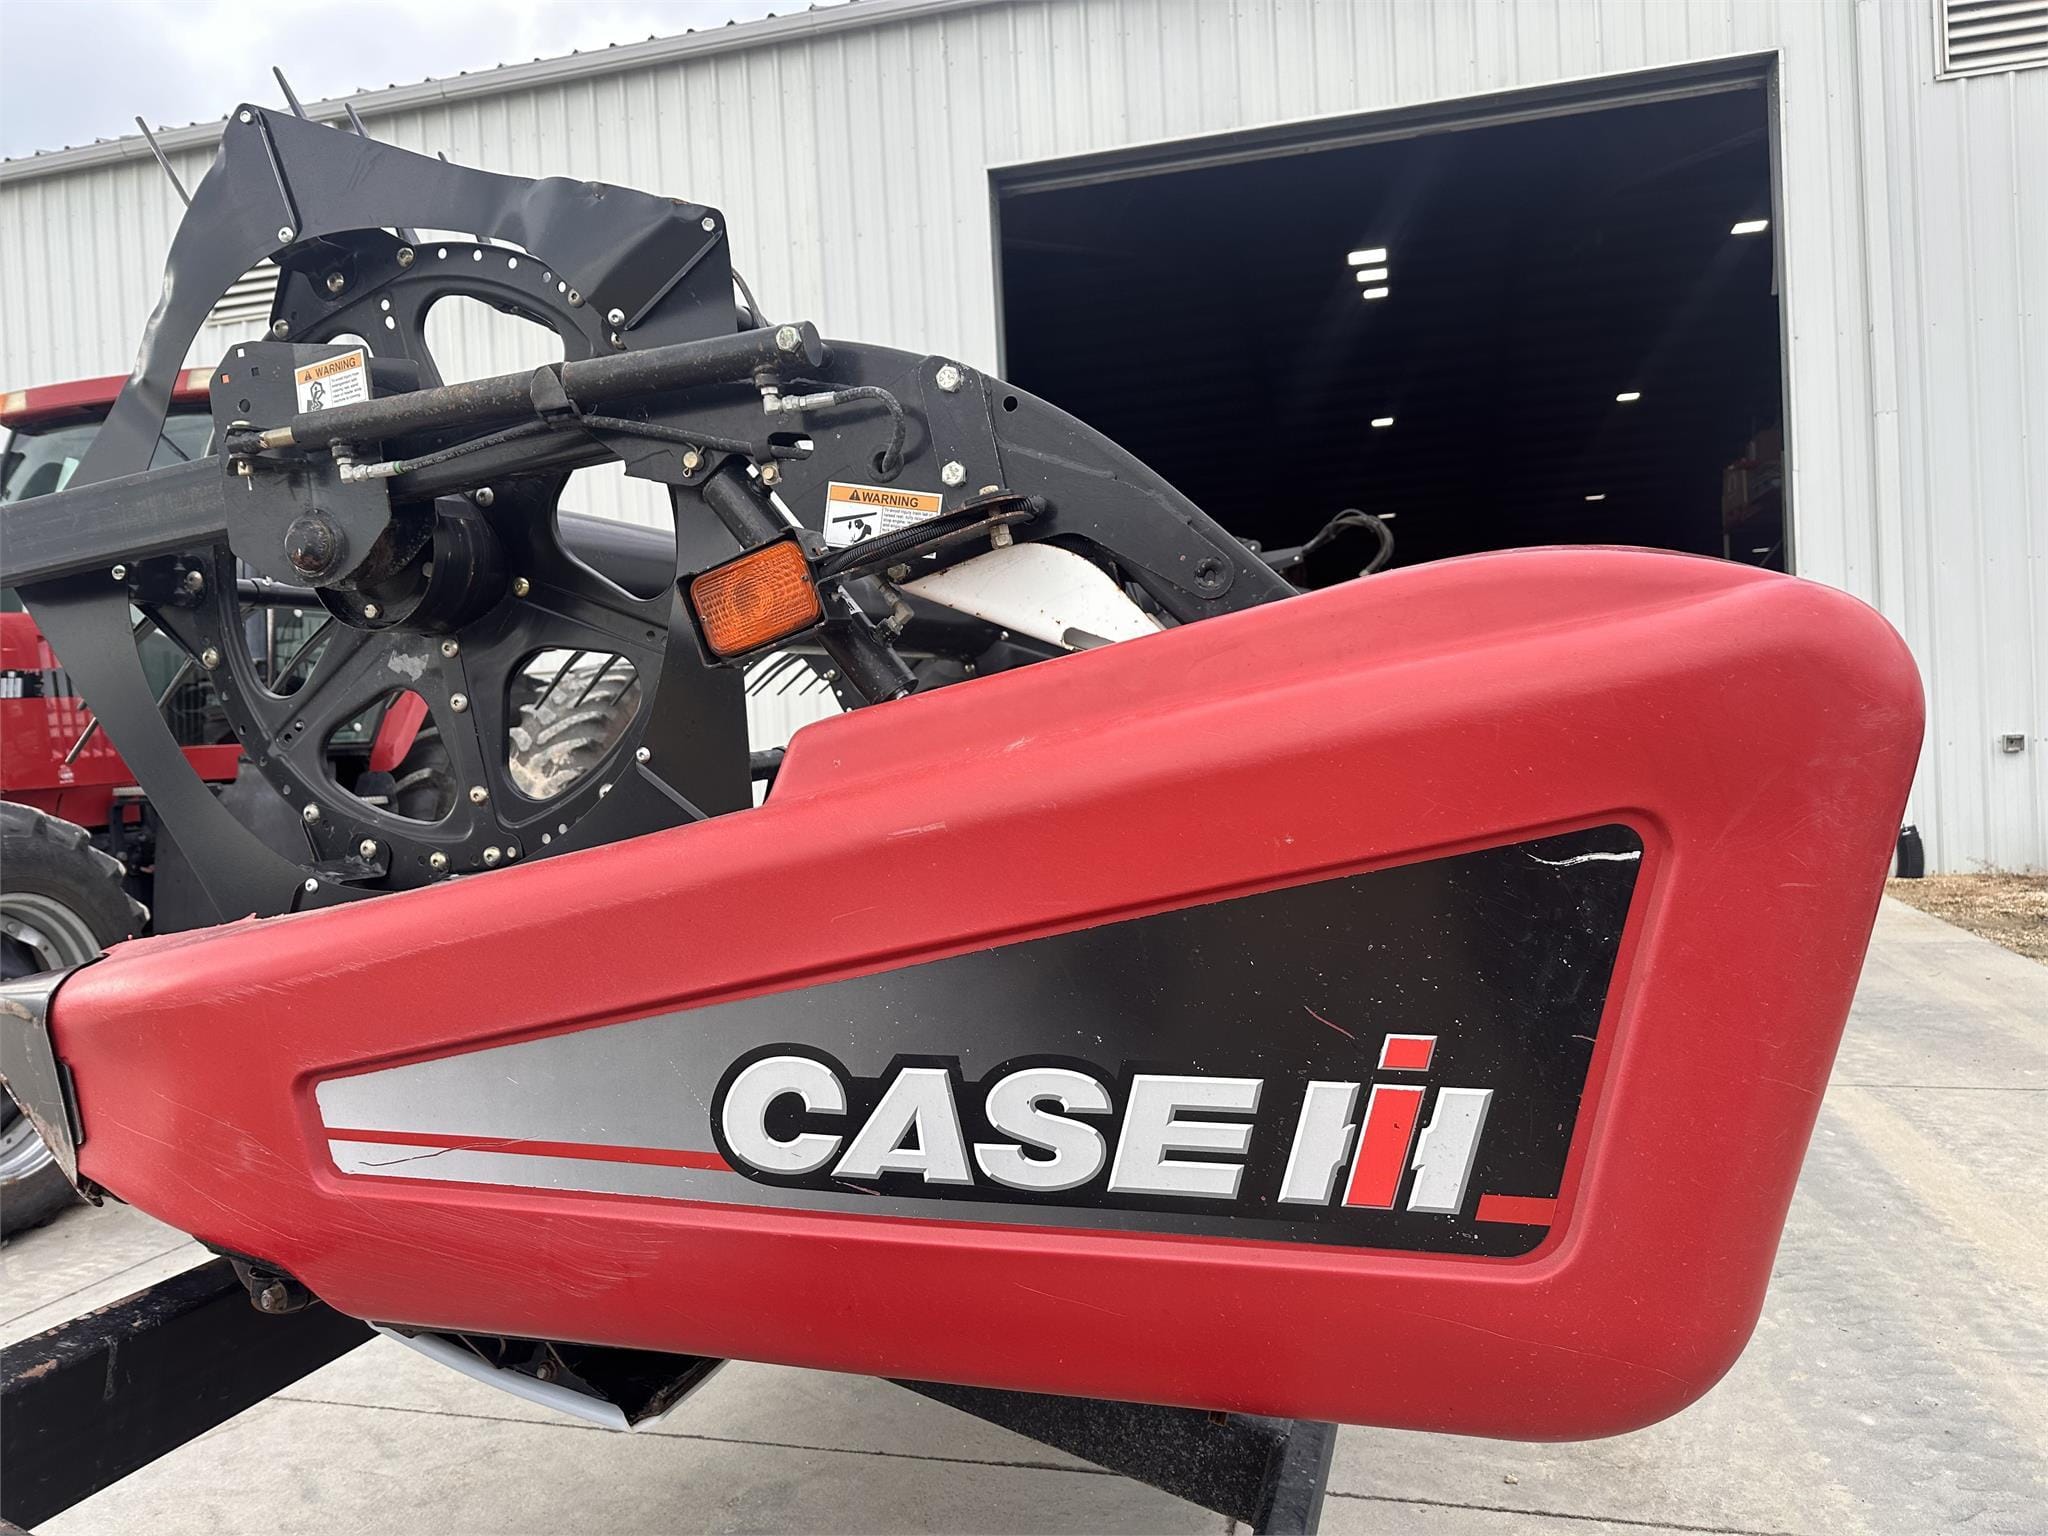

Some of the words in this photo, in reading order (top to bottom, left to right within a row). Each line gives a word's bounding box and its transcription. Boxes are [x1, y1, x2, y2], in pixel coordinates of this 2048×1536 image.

[315, 357, 356, 378] WARNING
[862, 491, 919, 508] WARNING
[721, 1055, 1262, 1199] CASE
[1277, 1033, 1495, 1213] IH
